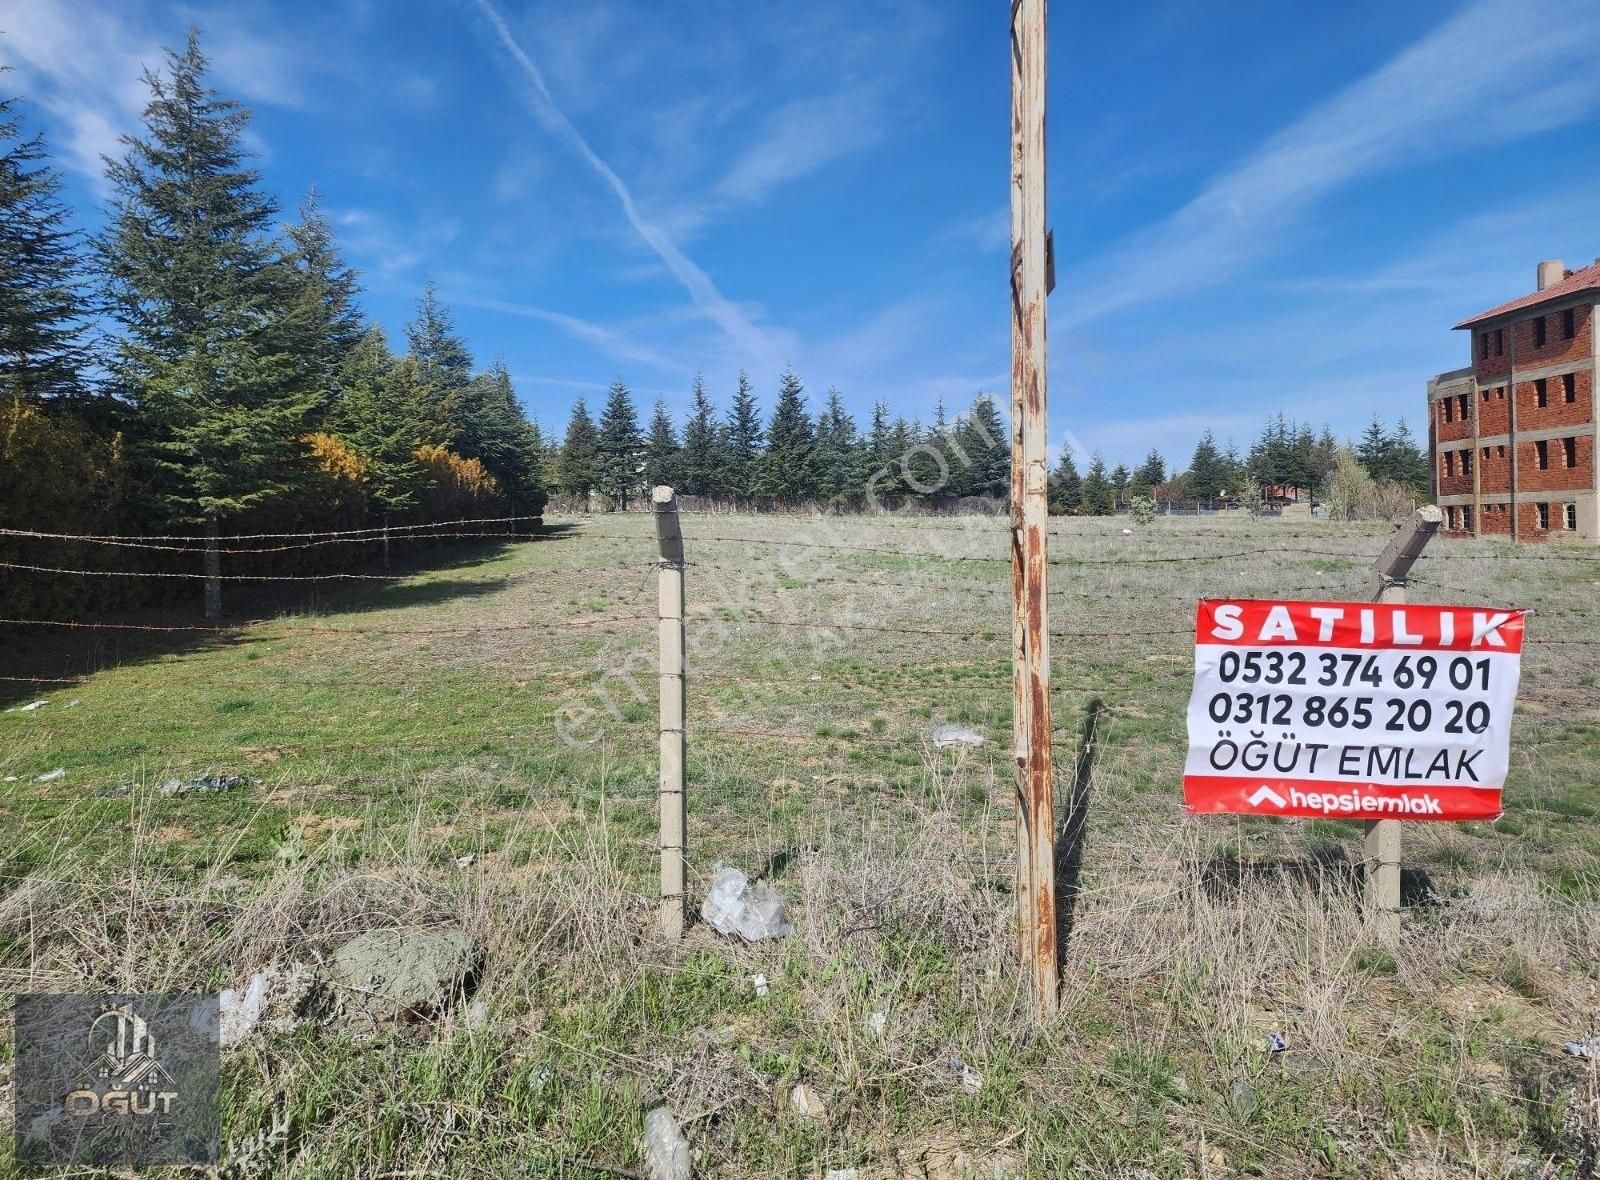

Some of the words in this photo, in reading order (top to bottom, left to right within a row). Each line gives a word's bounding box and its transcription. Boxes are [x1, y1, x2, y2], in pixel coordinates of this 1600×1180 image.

[1210, 605, 1507, 646] SATILIK
[1219, 651, 1306, 685] 0532
[1318, 653, 1382, 687] 374
[1393, 655, 1437, 690] 69
[1449, 657, 1490, 691] 01
[1208, 692, 1292, 726] 0312
[1302, 696, 1373, 729] 865
[1386, 698, 1432, 732] 20
[1444, 701, 1491, 734] 20
[1209, 730, 1329, 772] ÖĞÜT
[1338, 745, 1484, 782] EMLAK
[1290, 788, 1443, 815] hepsiemlak
